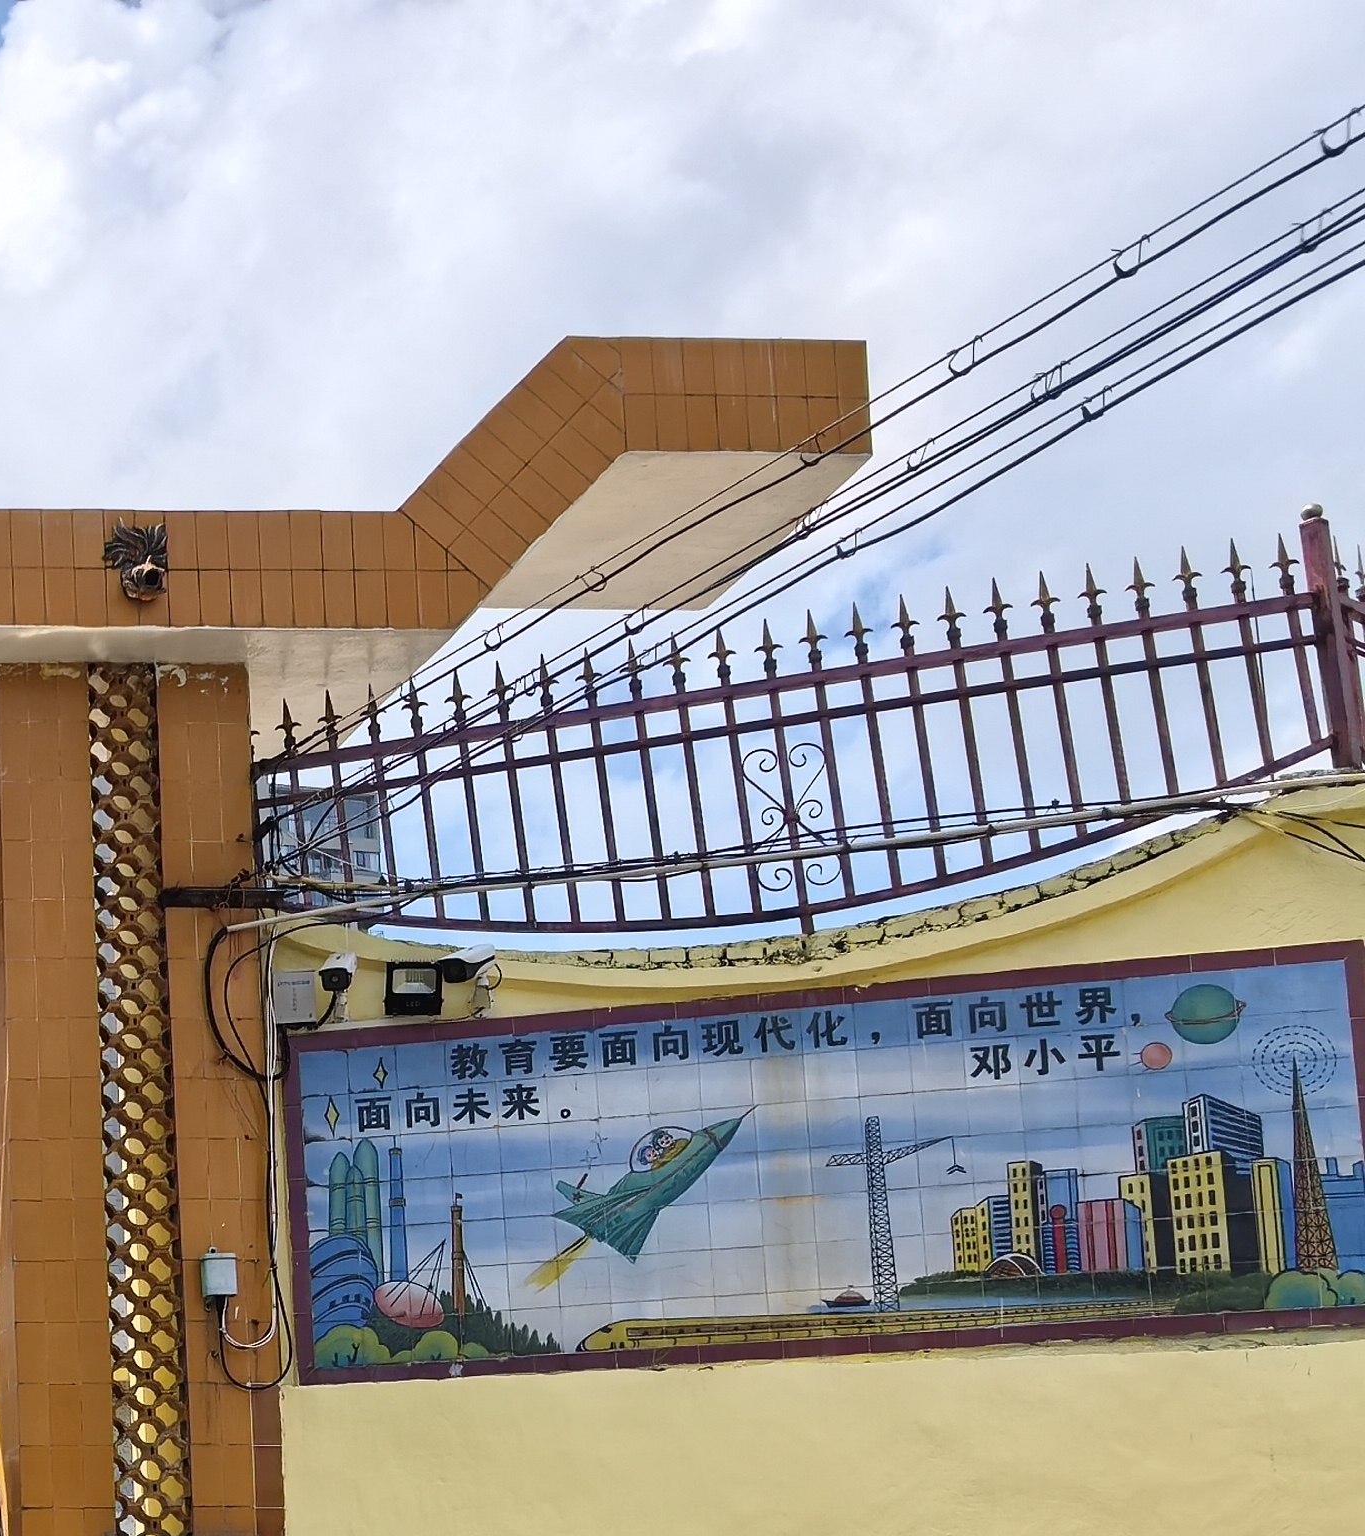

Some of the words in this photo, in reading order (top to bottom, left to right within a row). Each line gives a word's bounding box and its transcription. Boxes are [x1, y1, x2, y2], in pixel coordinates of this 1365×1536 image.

[450, 987, 1141, 1081] 教育要面向现代化，面向世界，
[970, 1034, 1120, 1080] 邓小平
[355, 1084, 571, 1132] 面向未来。
